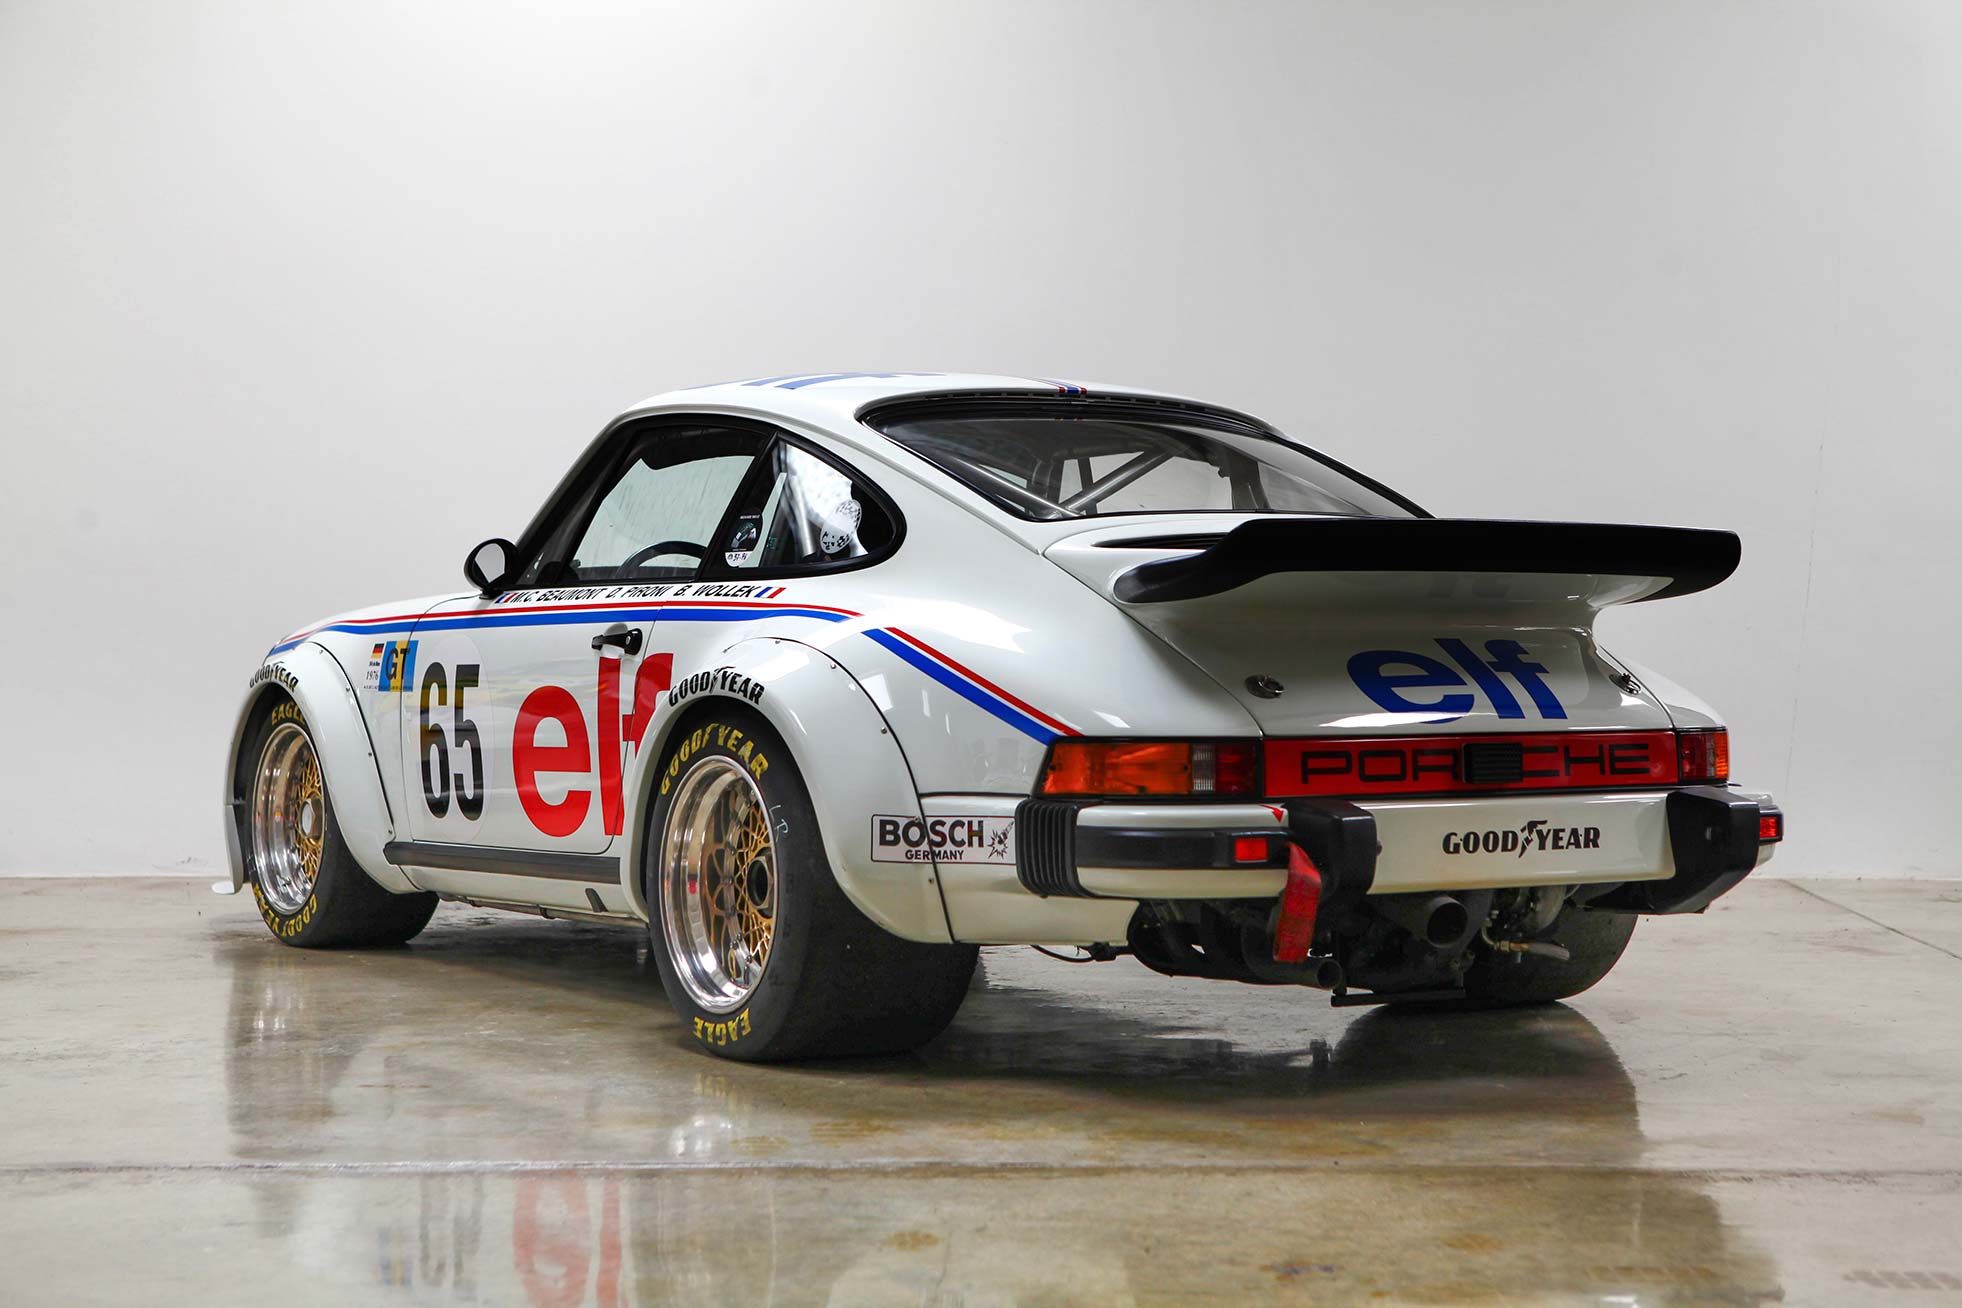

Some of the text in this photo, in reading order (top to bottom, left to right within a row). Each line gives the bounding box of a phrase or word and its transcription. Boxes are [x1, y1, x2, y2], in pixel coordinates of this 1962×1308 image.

[511, 584, 761, 603] M.C. BEAUMONT D. PIRONI B. WOLLEK
[386, 647, 411, 681] GT
[1346, 638, 1568, 724] elf
[420, 662, 484, 821] 65
[1302, 743, 1650, 784] PORCHE
[879, 819, 984, 848] BOSCH
[905, 849, 964, 861] GERMANY
[692, 1007, 752, 1047] EAGLE
